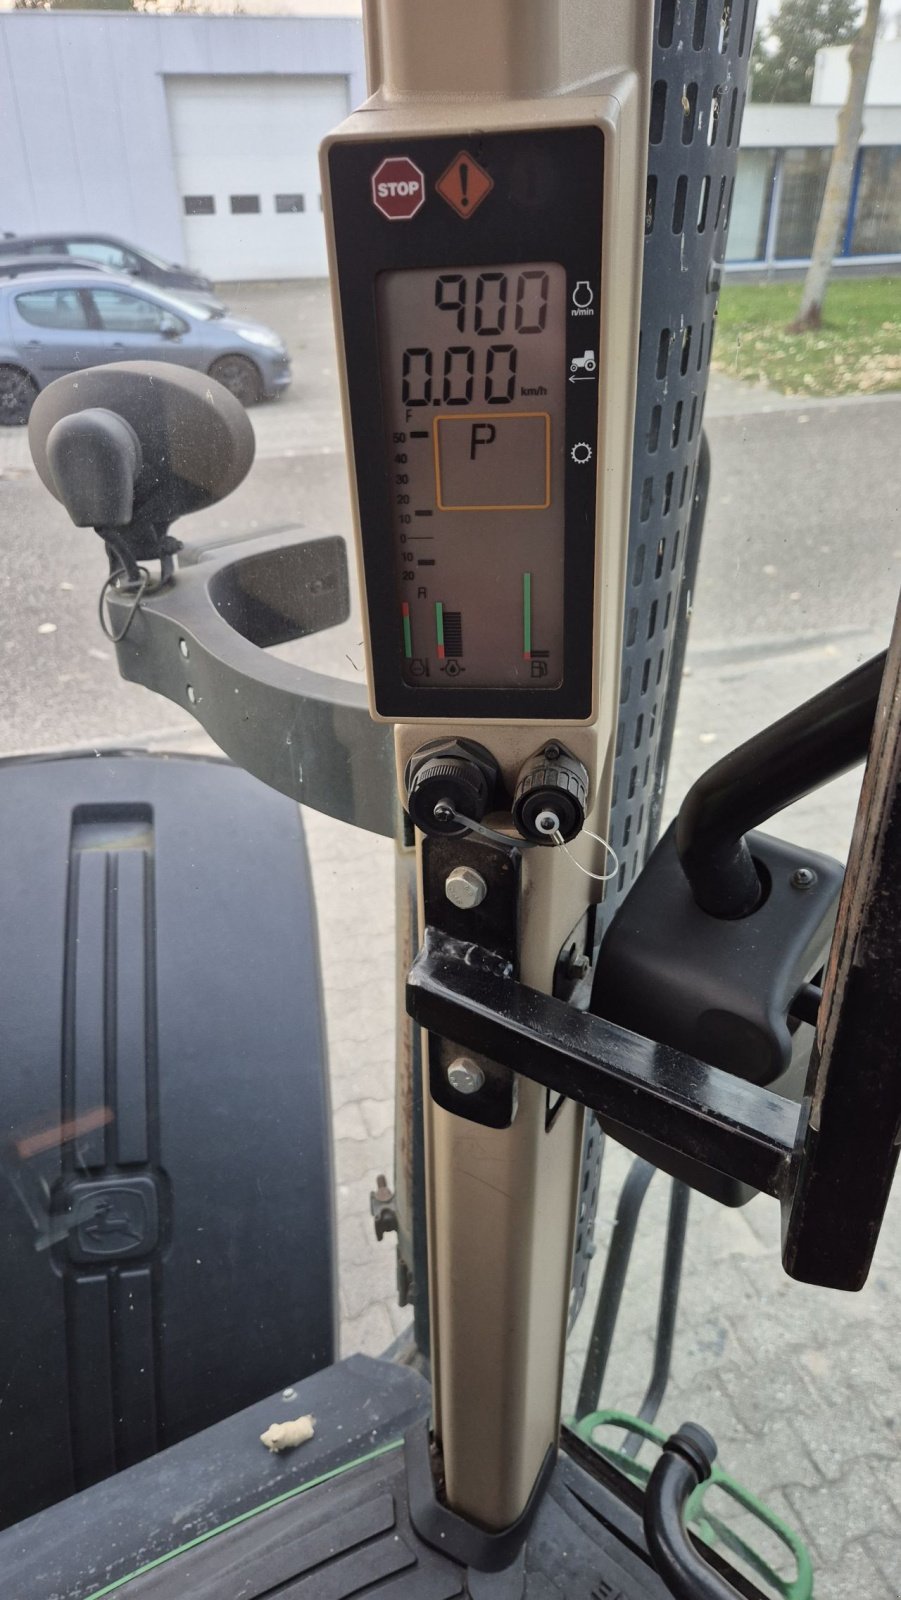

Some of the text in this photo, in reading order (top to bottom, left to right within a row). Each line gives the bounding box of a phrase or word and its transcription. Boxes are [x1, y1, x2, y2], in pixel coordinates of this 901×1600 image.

[377, 181, 420, 197] STOP
[435, 270, 549, 336] 900
[571, 308, 594, 316] n/min
[401, 344, 547, 407] 0.00 km/h
[405, 408, 413, 423] F
[392, 432, 406, 443] 50
[470, 423, 497, 460] P
[395, 453, 408, 464] 40
[395, 474, 409, 485] 30
[396, 494, 410, 505] 20
[398, 514, 411, 524] 10
[401, 552, 414, 562] 10
[402, 571, 415, 581] 20
